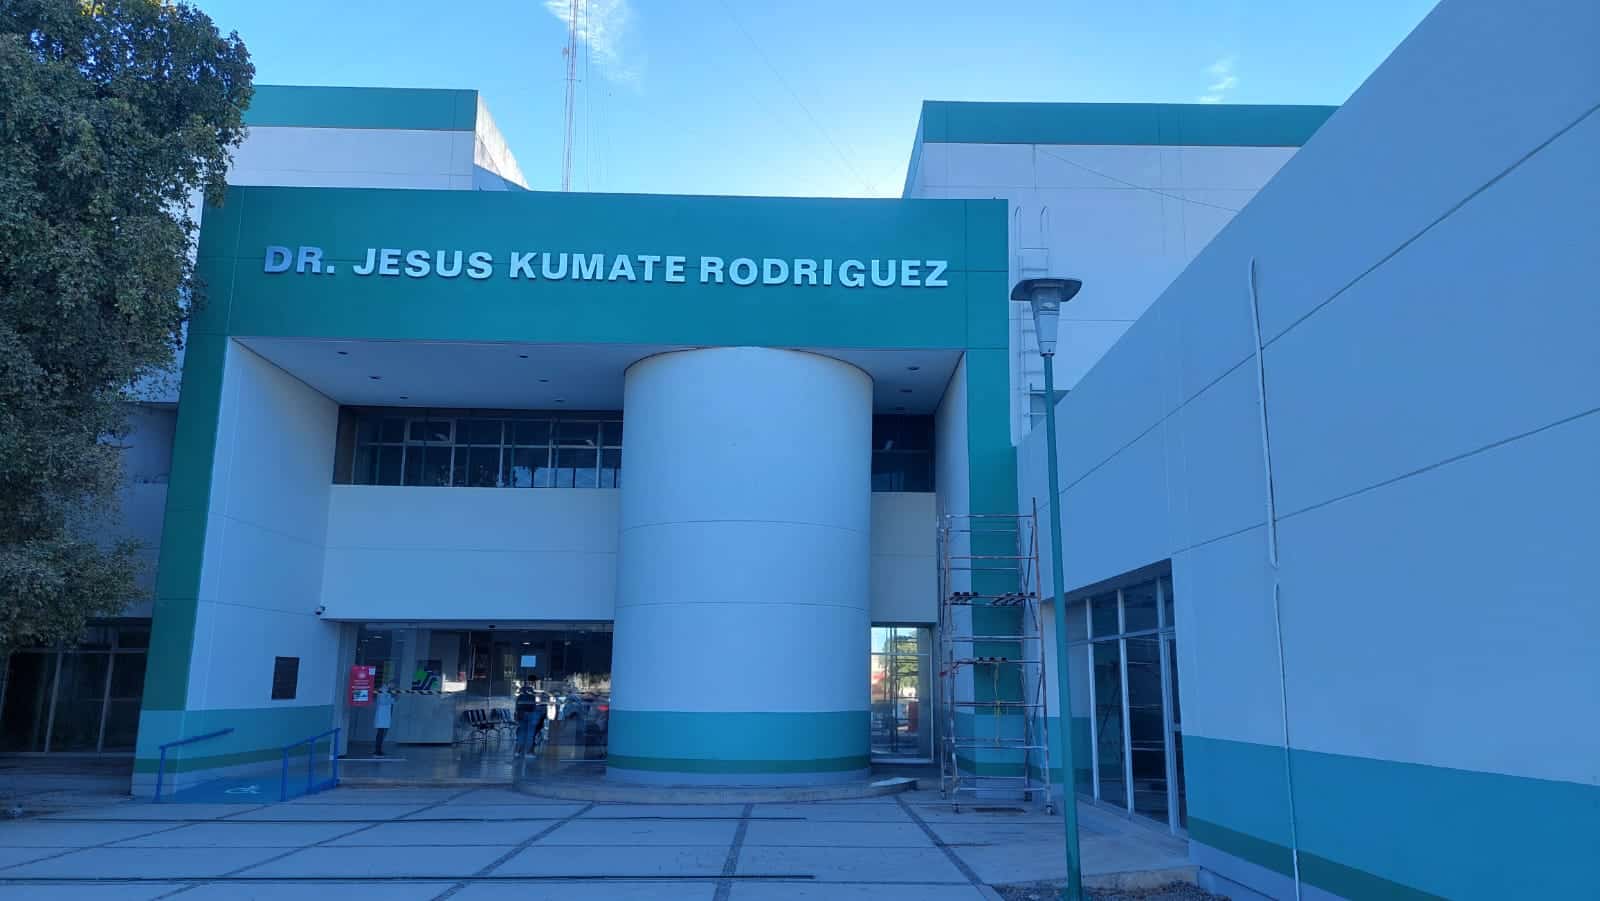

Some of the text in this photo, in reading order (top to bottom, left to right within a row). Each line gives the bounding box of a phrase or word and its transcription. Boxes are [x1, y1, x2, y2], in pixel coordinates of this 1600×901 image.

[264, 246, 949, 288] DR. JESUS KUMATE RODRIGUEZ
